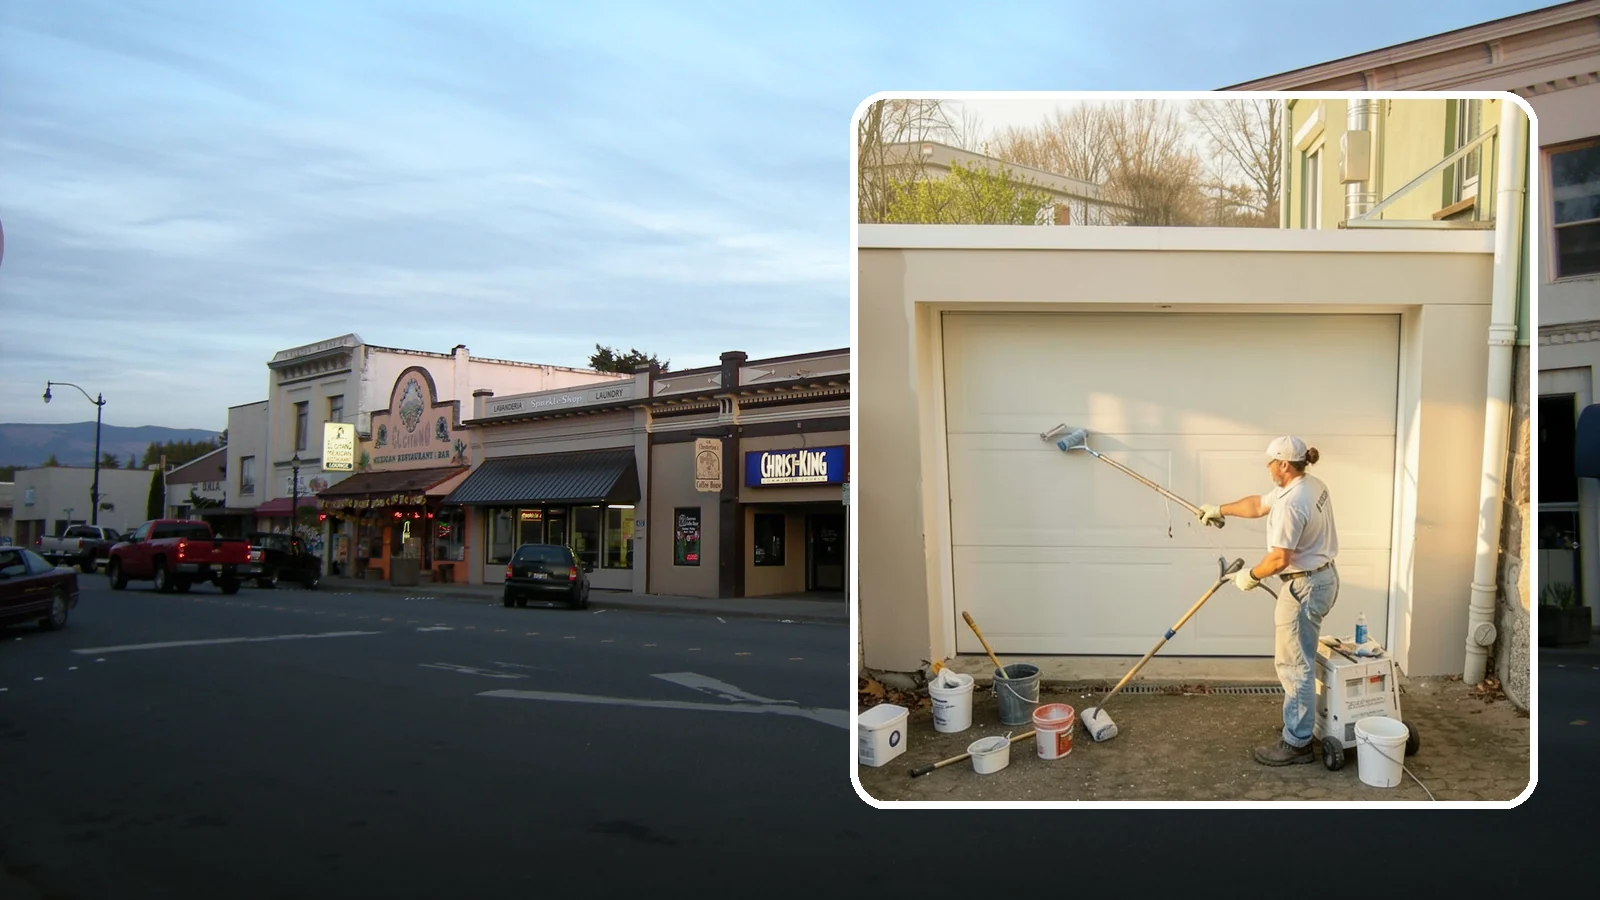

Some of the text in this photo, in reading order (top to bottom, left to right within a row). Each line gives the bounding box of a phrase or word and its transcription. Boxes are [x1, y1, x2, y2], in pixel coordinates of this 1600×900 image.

[530, 394, 582, 409] Sparkle Shop
[595, 389, 623, 400] LAUNDRY
[493, 402, 522, 413] LAVANDERIA
[373, 454, 396, 464] MEXICAN
[397, 452, 433, 462] RESTAURANT
[438, 450, 450, 459] BAR
[760, 450, 828, 477] CHRIST KING
